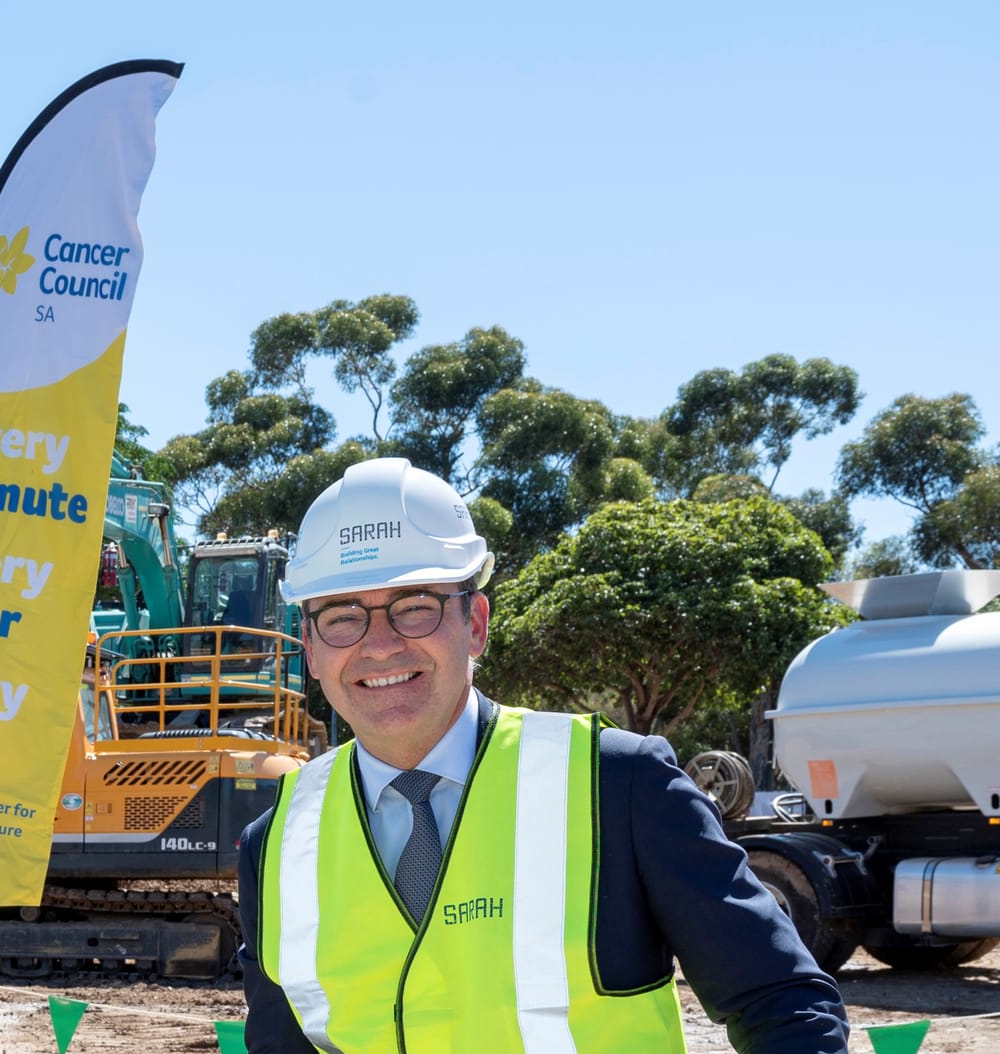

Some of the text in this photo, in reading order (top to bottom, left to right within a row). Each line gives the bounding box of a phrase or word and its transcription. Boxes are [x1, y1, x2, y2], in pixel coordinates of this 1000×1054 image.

[43, 233, 130, 267] Cancer
[39, 266, 128, 301] Council
[34, 304, 55, 323] SA
[339, 520, 401, 545] SARAH
[13, 802, 37, 819] for
[160, 837, 217, 851] 140LC-9
[443, 897, 504, 925] SARAH
